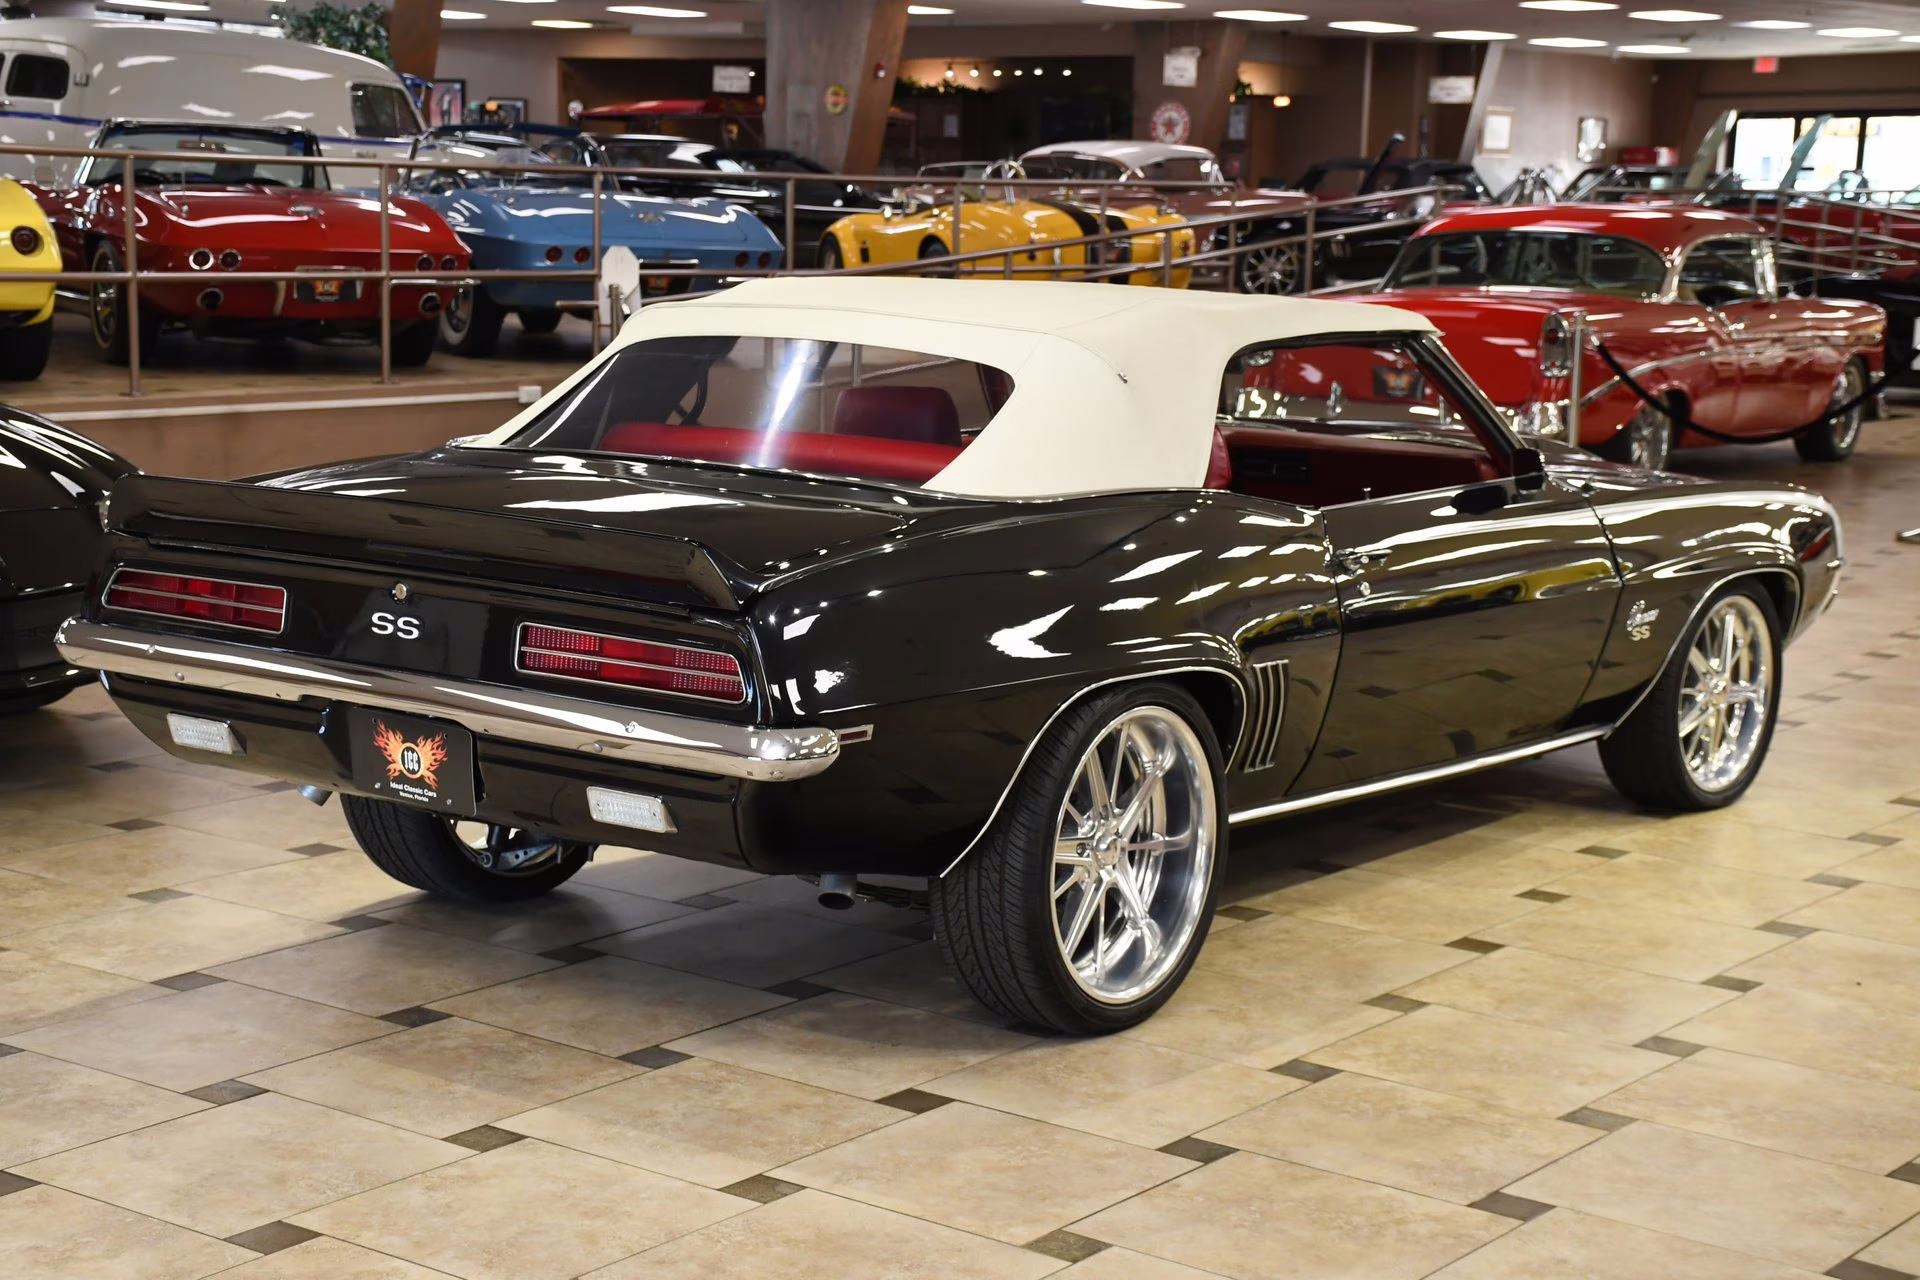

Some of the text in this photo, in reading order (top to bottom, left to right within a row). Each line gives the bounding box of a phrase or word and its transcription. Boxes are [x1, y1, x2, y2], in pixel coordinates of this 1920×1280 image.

[371, 611, 420, 639] SS
[1631, 625, 1651, 641] SS
[404, 750, 419, 771] ICC
[390, 781, 437, 797] Ideal Classic Cars
